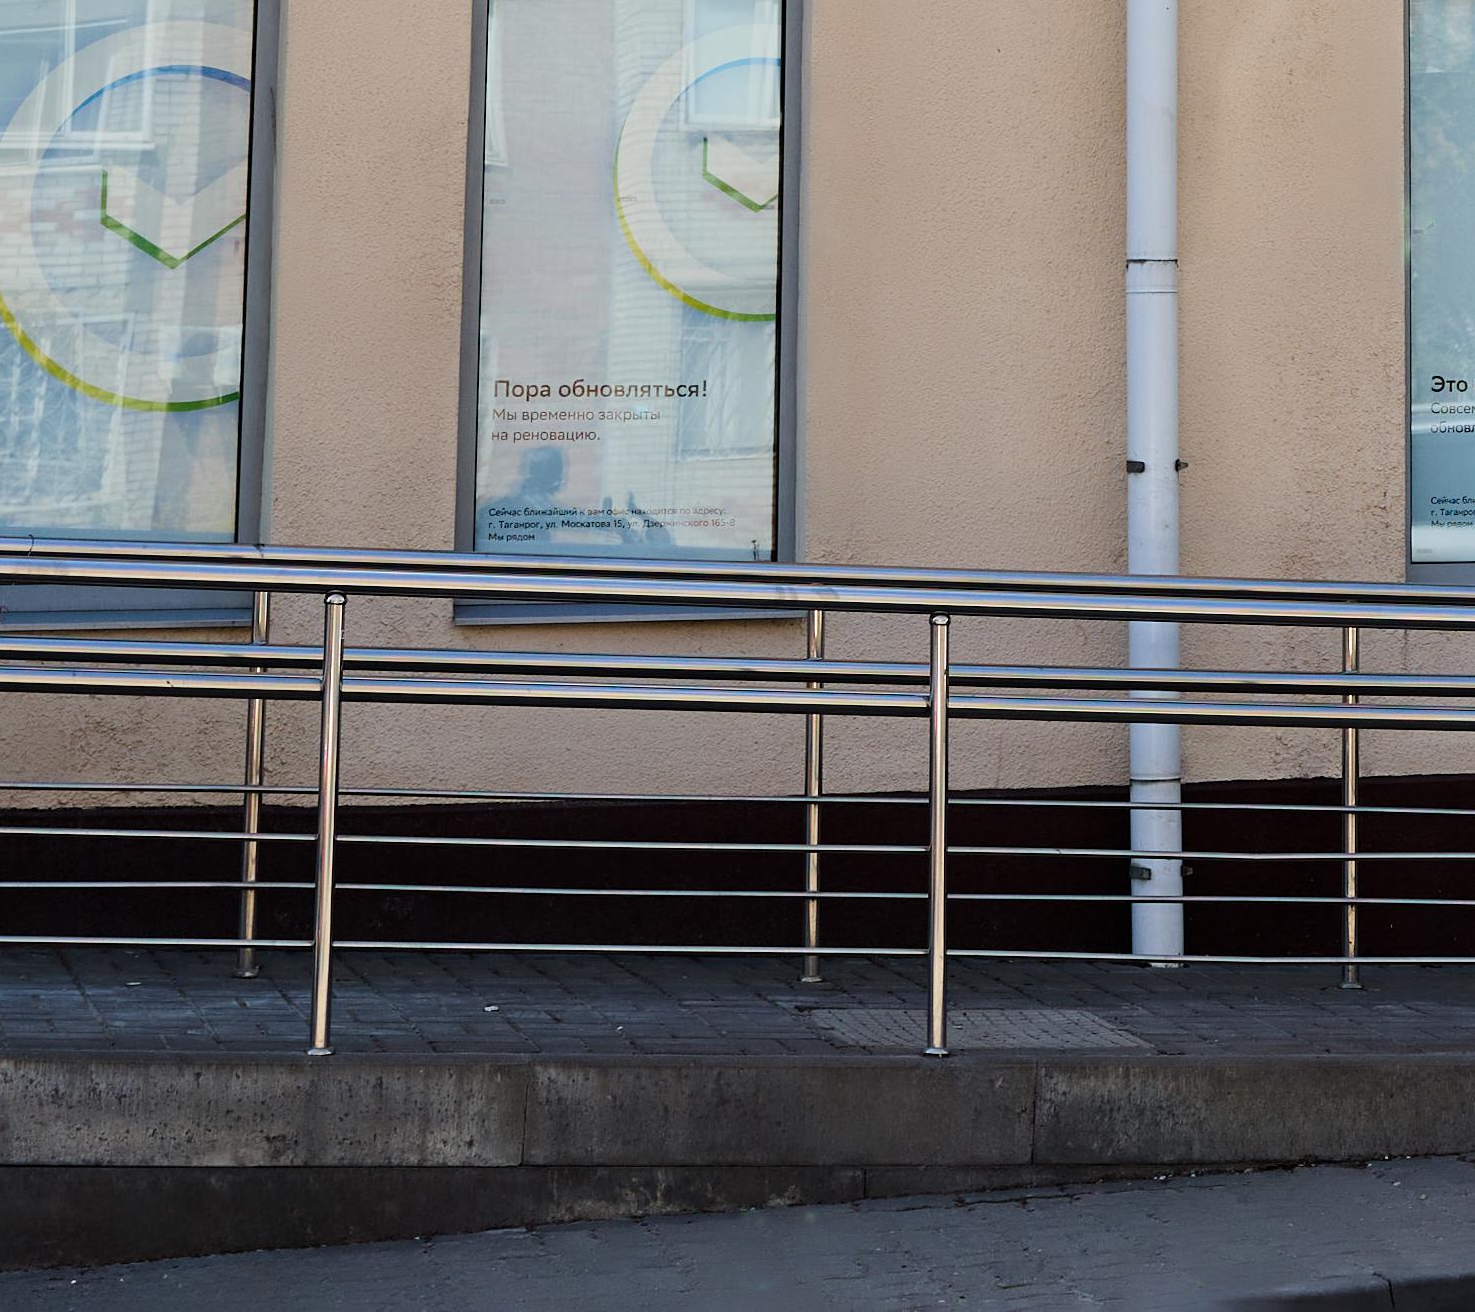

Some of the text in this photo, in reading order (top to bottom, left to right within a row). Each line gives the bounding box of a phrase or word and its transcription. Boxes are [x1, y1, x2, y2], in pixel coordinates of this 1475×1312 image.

[494, 379, 707, 401] Пора обновляться!
[1431, 376, 1467, 392] Это
[492, 409, 660, 423] Мы временно закрыты
[492, 431, 600, 443] на реновацию.
[489, 508, 521, 516] Сейчас
[524, 507, 577, 515] ближайший
[614, 520, 625, 528] 15,
